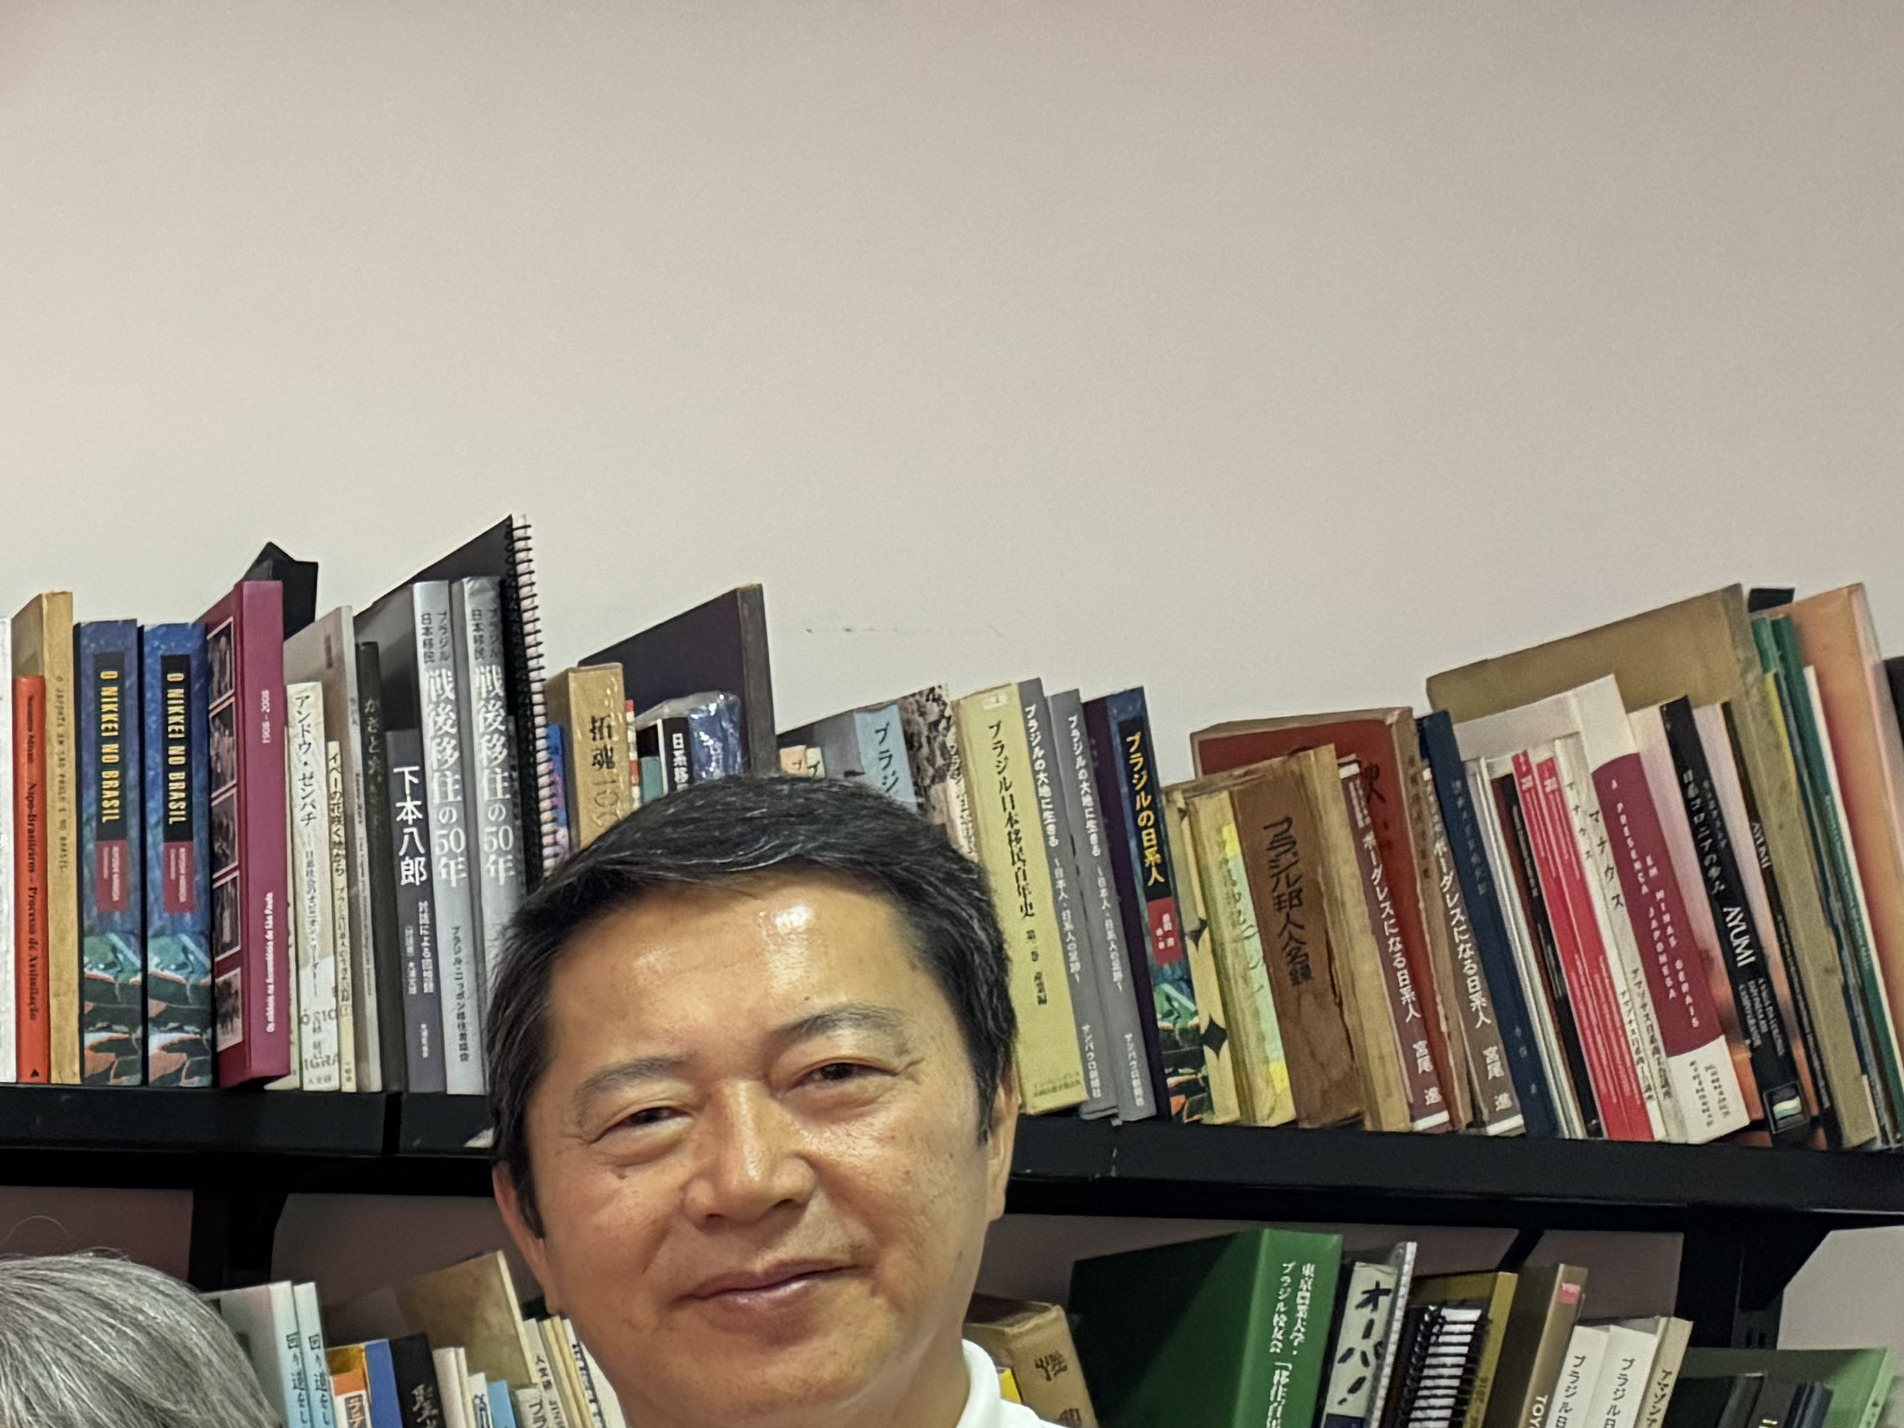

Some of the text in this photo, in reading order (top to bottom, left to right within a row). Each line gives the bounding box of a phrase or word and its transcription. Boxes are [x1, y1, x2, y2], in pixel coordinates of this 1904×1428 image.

[101, 671, 118, 680] O
[101, 689, 120, 739] NIKKEI
[101, 743, 120, 765] NO
[102, 770, 121, 825] BRASIL
[167, 690, 188, 825] NIKKEI NO BRASIL
[424, 667, 469, 889] 戦後移住の50年
[474, 665, 517, 887] 戦後移住の50年
[1126, 731, 1166, 887] ブラジルの日系人
[392, 764, 428, 887] 下本八郎
[1751, 820, 1773, 871] AYUMI
[1361, 832, 1422, 1024] ボーダレスになる日系人
[1433, 839, 1492, 1029] ボーダレスになる日系人
[1647, 905, 1679, 1001] JAPONESA
[1655, 888, 1701, 1030] MINAS GERAIS
[1722, 905, 1756, 968] AYUMI
